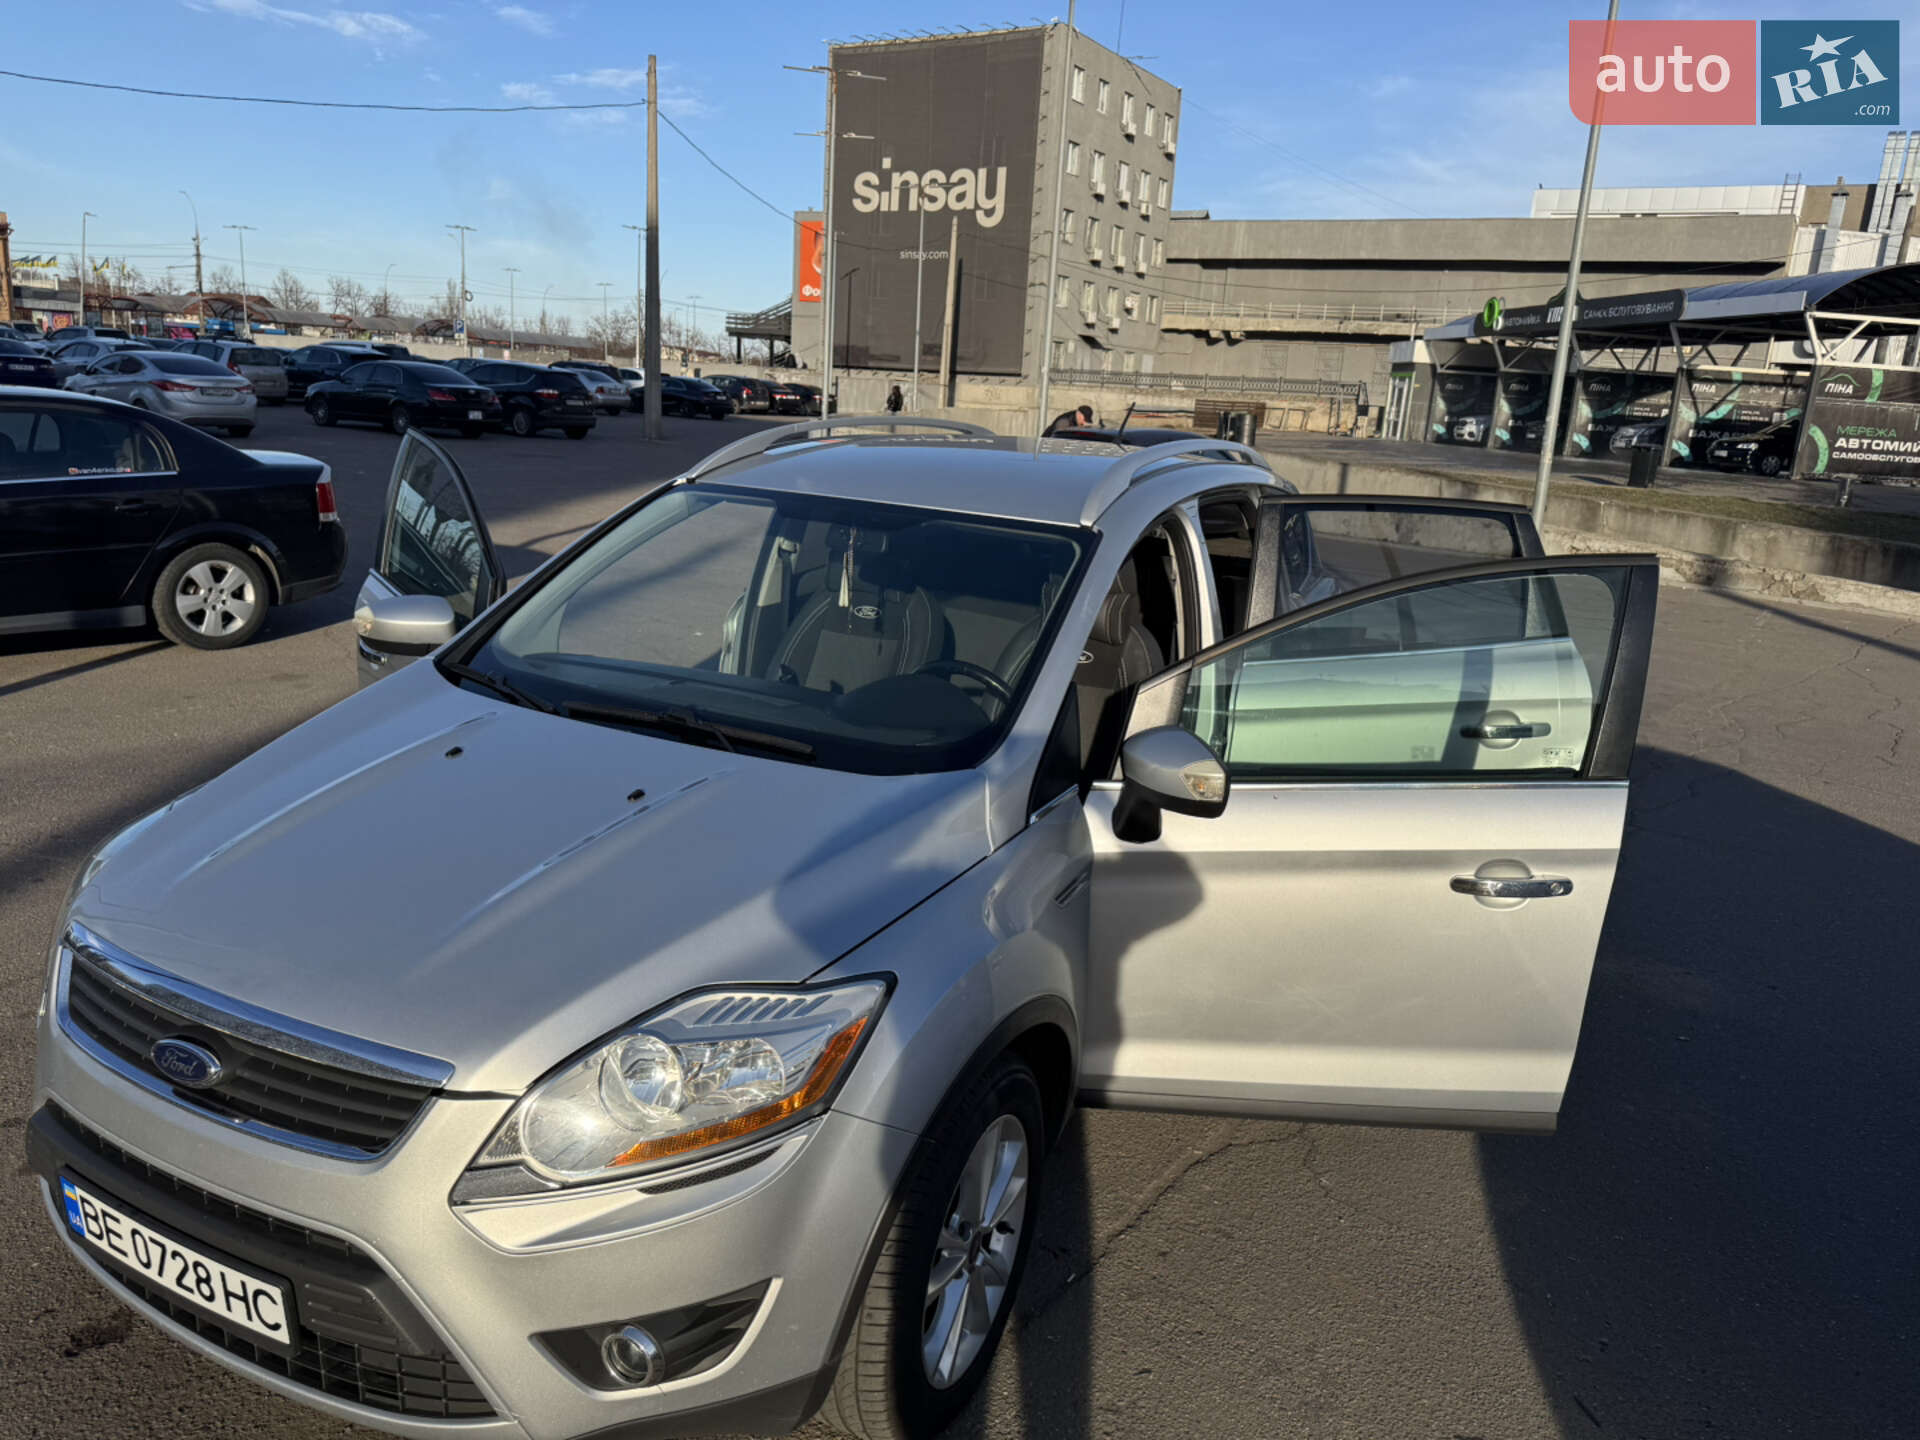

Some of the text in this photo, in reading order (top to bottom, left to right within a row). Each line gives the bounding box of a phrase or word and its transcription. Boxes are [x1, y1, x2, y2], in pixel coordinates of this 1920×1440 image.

[852, 157, 1007, 228] sinsay
[899, 248, 949, 262] sinsay.com
[1691, 383, 1716, 393] ПІНА
[1824, 383, 1854, 394] ПІНА
[1836, 425, 1897, 438] МЕРЕЖА
[160, 1047, 199, 1077] Ford
[69, 1212, 83, 1228] UA
[79, 1195, 283, 1331] BE 0728 HC
